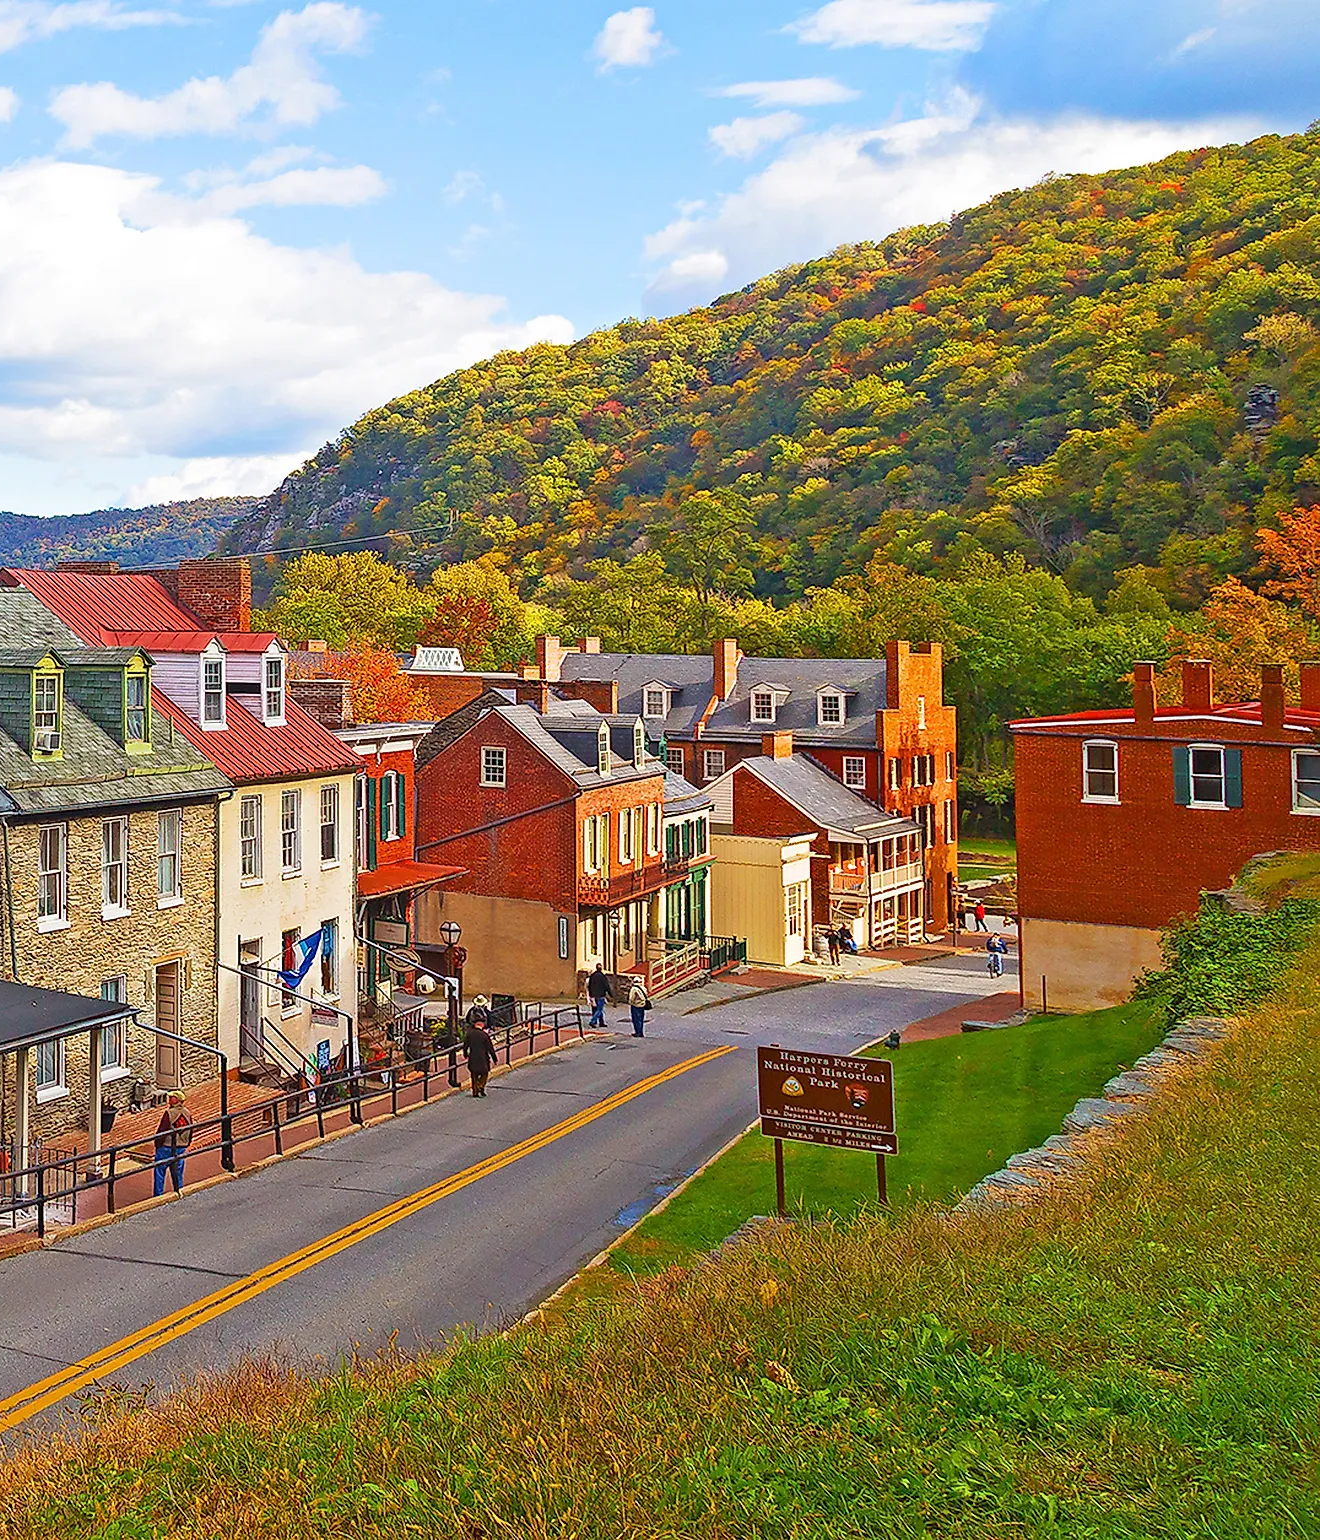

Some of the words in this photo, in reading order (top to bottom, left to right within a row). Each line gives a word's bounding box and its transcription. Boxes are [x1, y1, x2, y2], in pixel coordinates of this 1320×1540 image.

[780, 1052, 829, 1066] Harpers
[834, 1058, 868, 1071] Ferry
[764, 1060, 816, 1074] National
[822, 1067, 886, 1083] Historical
[809, 1076, 839, 1089] Park
[784, 1104, 816, 1114] National
[840, 1112, 868, 1120] Service
[784, 1111, 827, 1122] Department
[775, 1121, 806, 1131] VISITOR
[810, 1126, 842, 1136] CENTER
[846, 1131, 882, 1141] PARKING
[786, 1130, 814, 1140] AHEAD
[845, 1140, 870, 1148] MILES
